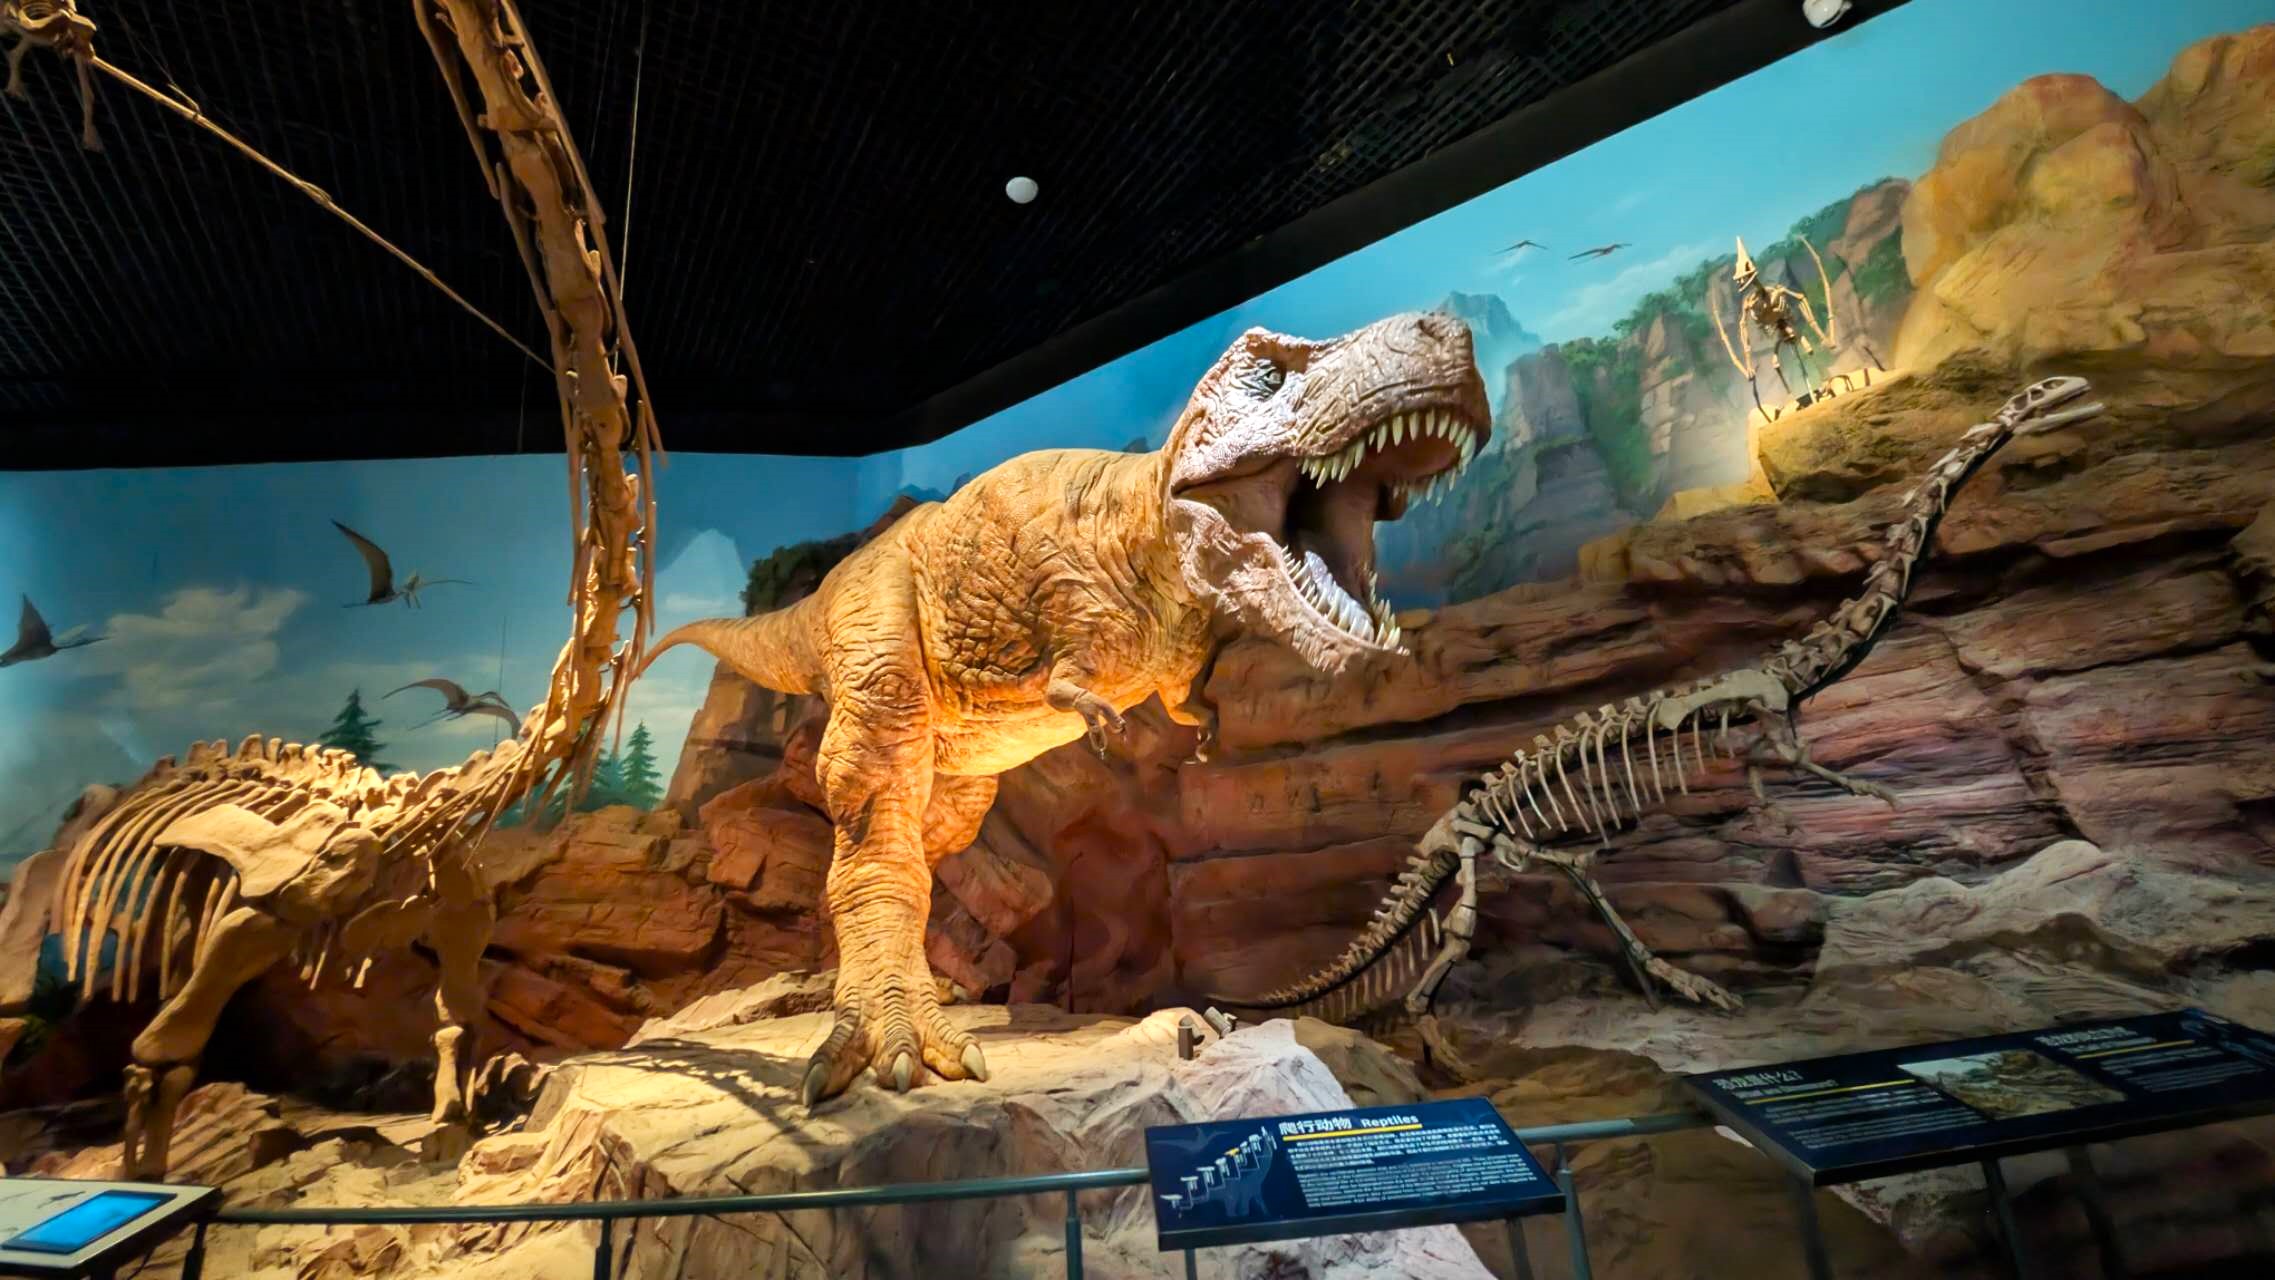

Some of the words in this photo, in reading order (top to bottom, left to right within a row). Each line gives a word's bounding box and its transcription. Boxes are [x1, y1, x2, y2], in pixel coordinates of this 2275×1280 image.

[1278, 1117, 1352, 1135] 爬行动物
[1361, 1115, 1419, 1128] Reptiles
